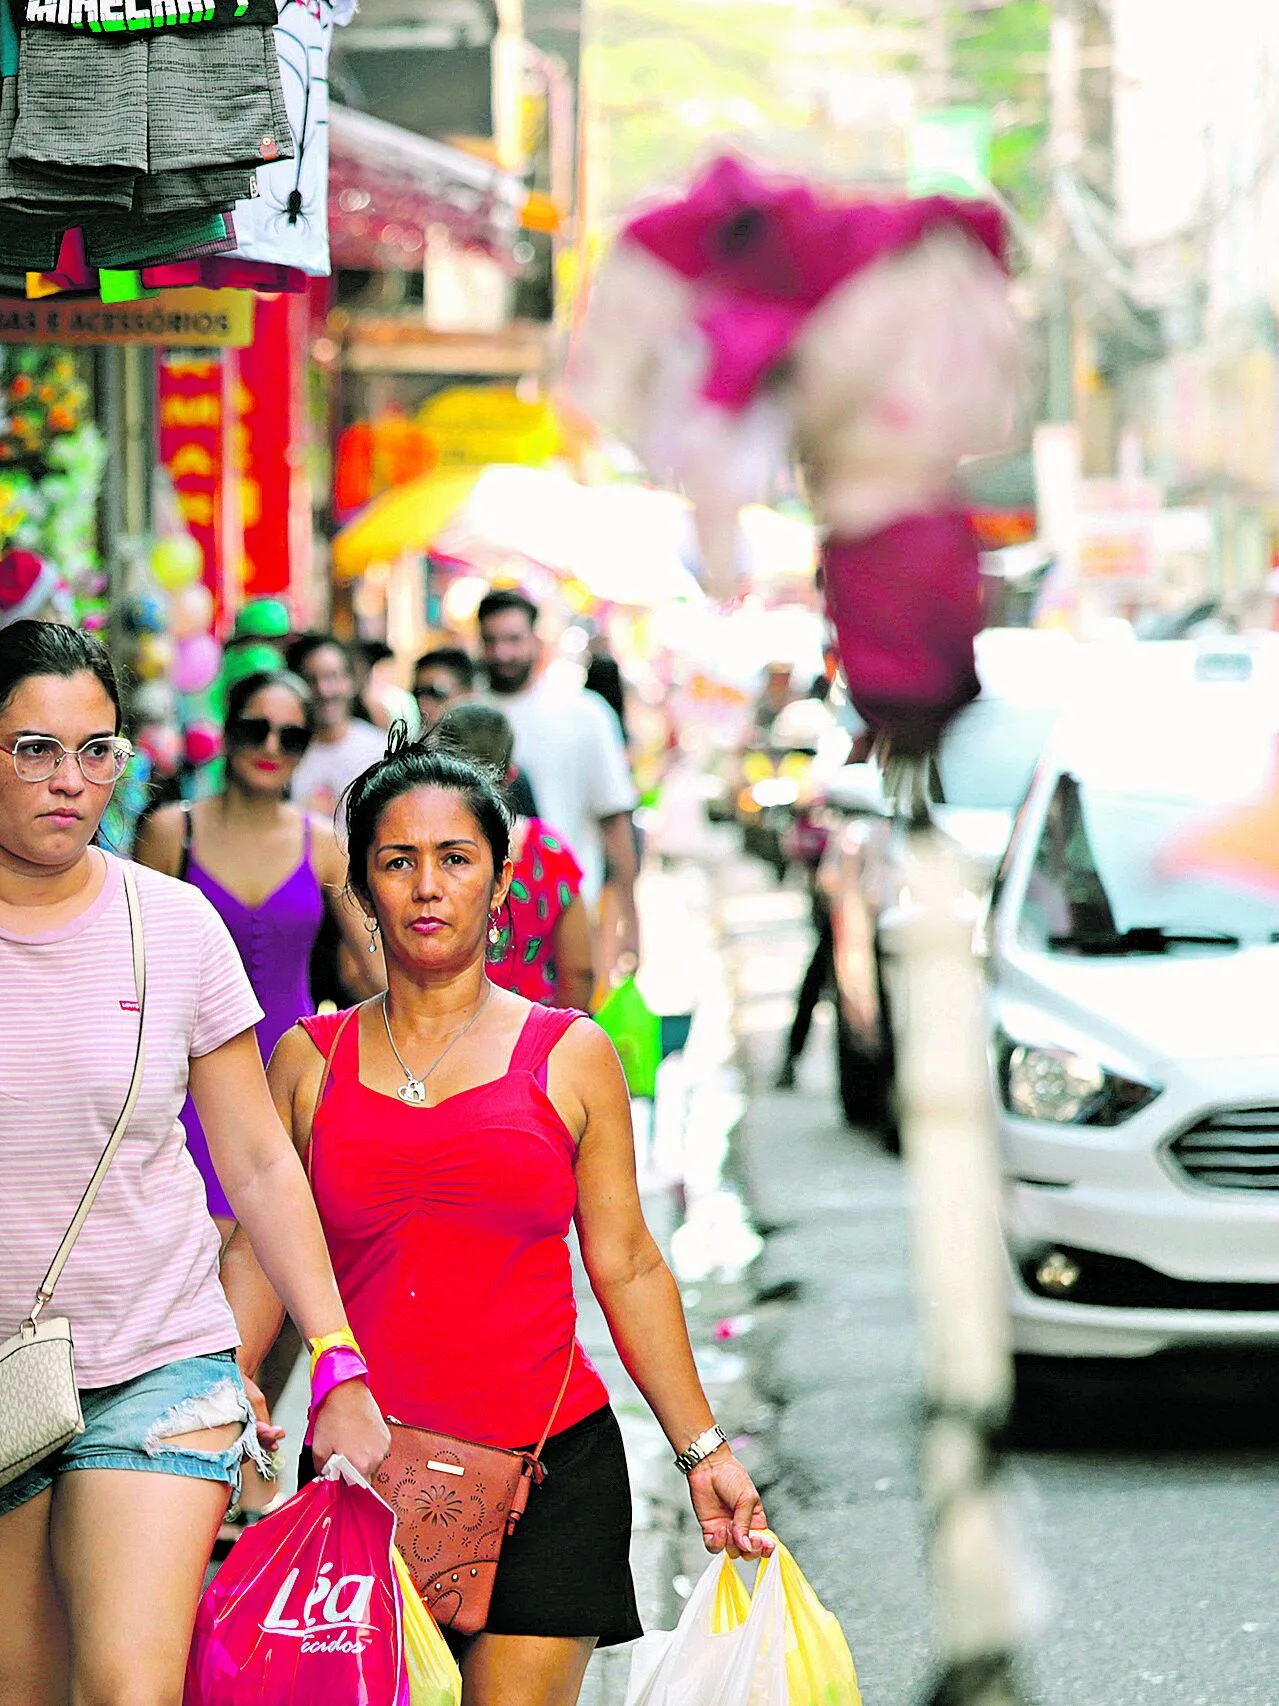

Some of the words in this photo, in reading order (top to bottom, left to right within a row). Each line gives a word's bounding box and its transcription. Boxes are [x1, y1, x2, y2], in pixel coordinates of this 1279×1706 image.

[26, 0, 248, 31] MINEC
[71, 306, 231, 333] ACESSÓRIOS
[263, 1561, 376, 1628] Léa
